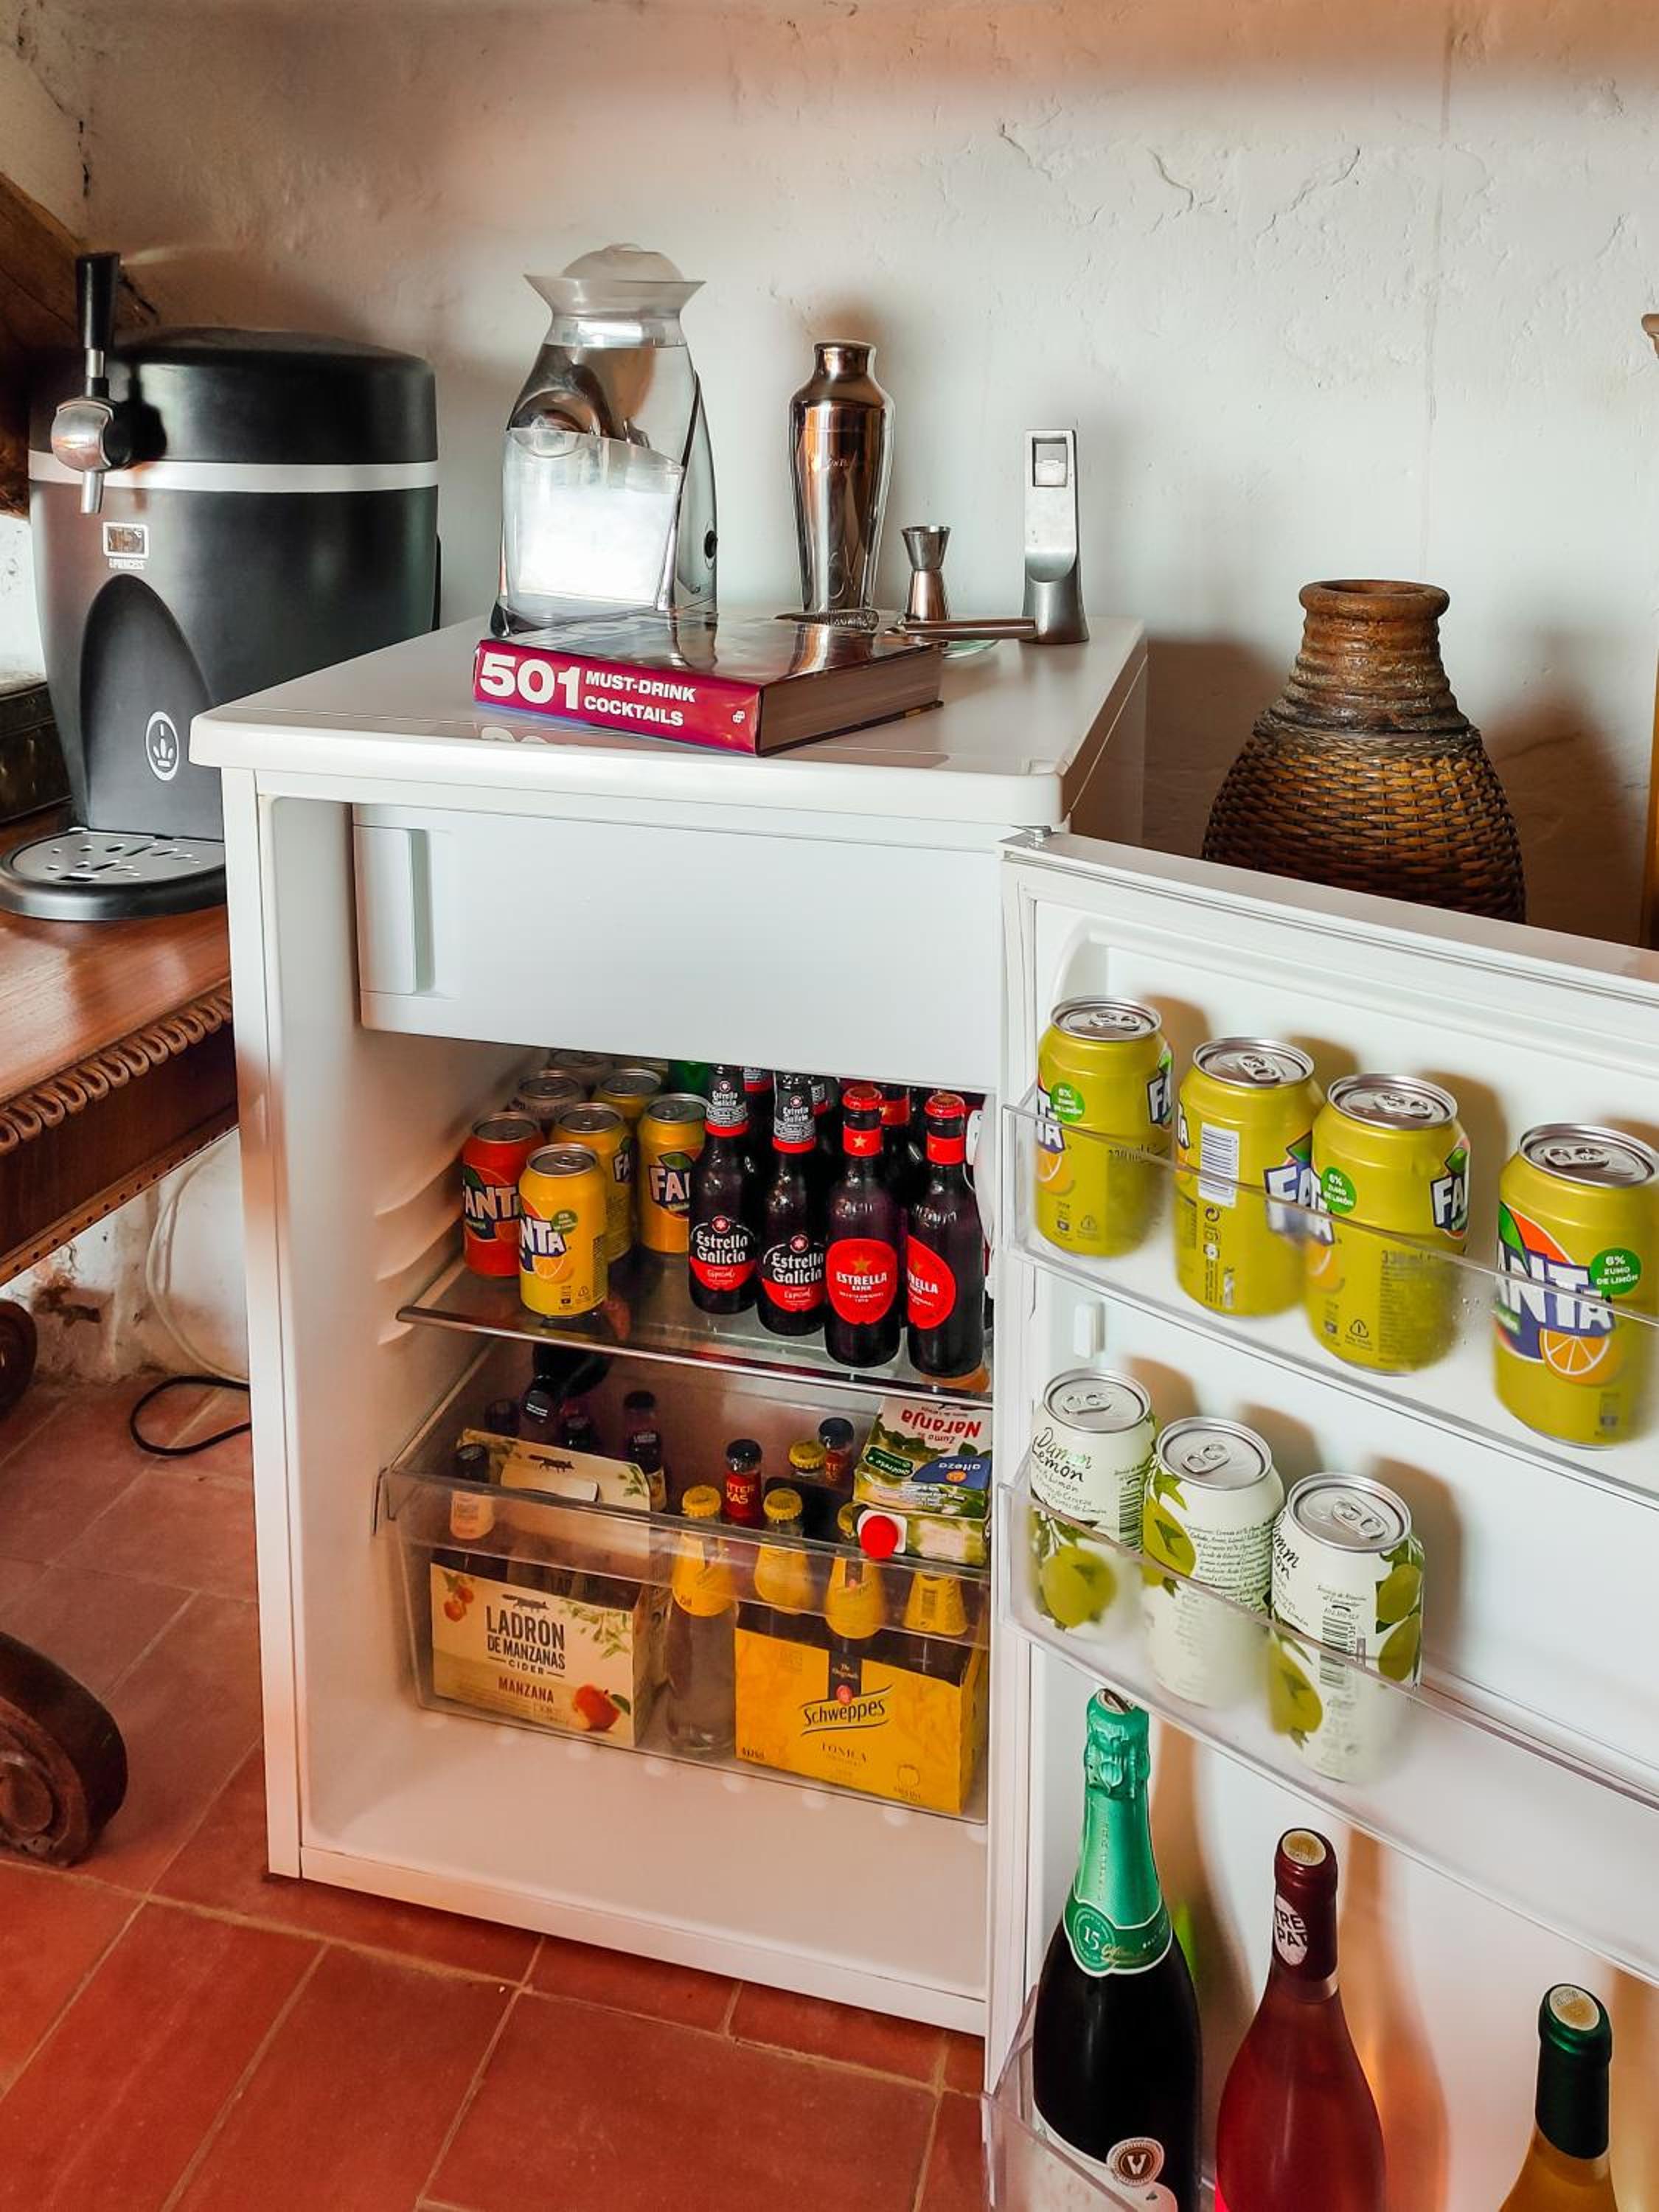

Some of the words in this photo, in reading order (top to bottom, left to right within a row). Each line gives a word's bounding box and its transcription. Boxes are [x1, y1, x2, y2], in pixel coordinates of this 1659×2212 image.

[479, 653, 580, 709] 501
[585, 670, 697, 703] MUST-DRINK
[584, 696, 684, 727] COCKTAILS
[465, 1185, 519, 1220] ANT
[519, 1215, 566, 1254] NTA
[695, 1231, 748, 1250] Estrella
[697, 1246, 746, 1264] Galicia
[771, 1253, 824, 1269] Estrella
[1605, 1255, 1626, 1266] 6%
[772, 1267, 823, 1284] Galicia
[835, 1271, 888, 1285] ESTRELLA
[1596, 1277, 1609, 1286] DE
[1610, 1273, 1639, 1285] LIMÓN
[1604, 1266, 1631, 1276] ZUMO
[900, 1408, 981, 1439] Naranja
[938, 1462, 981, 1471] alteza
[486, 1605, 566, 1651] LADRÓN
[487, 1633, 501, 1654] DE
[502, 1638, 566, 1670] MANZANAS
[508, 1659, 545, 1675] CIDER
[498, 1676, 554, 1704] MANZANA
[803, 1698, 886, 1726] Schweppes
[1083, 1926, 1101, 1950] 15
[1127, 2153, 1147, 2174] V
